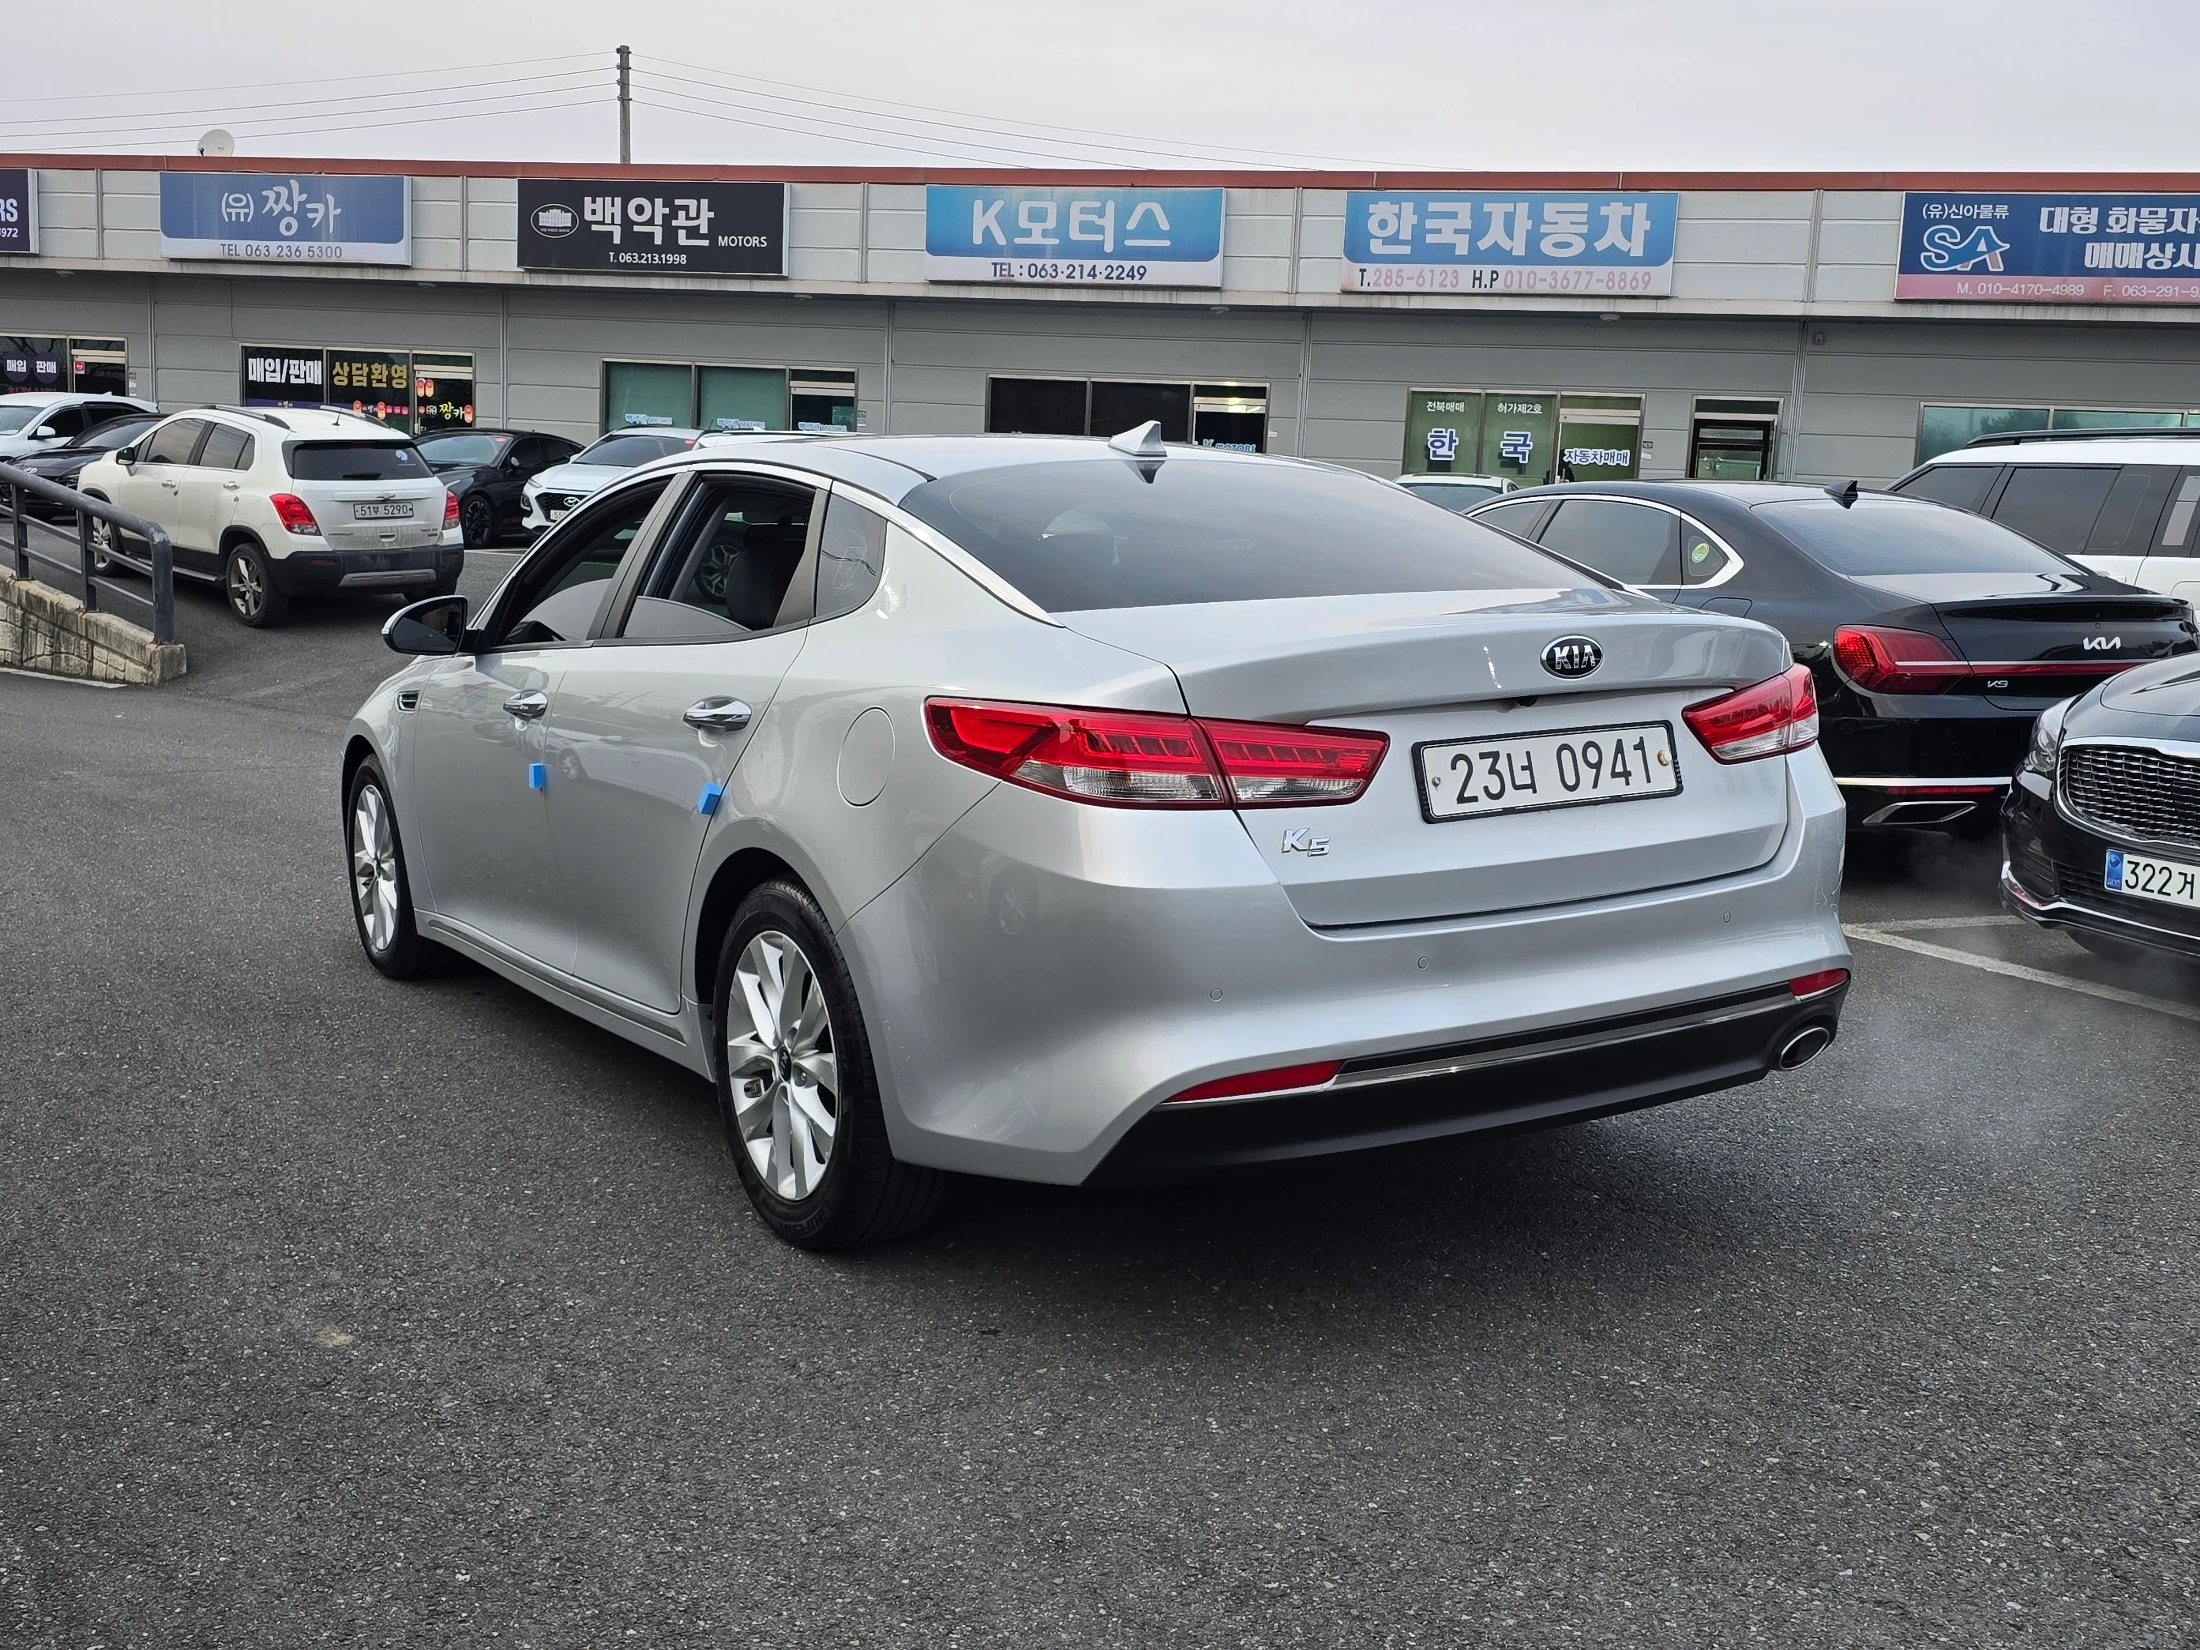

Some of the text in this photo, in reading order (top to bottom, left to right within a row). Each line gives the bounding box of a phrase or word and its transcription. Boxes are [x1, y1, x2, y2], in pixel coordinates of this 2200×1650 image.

[262, 179, 342, 237] 짱카
[584, 196, 768, 248] 백악관 MOTORS
[1922, 203, 2010, 220] (유)신아물류
[2039, 206, 2200, 235] 대형 화물자
[0, 227, 18, 238] 972
[972, 199, 1172, 253] K모터스
[1366, 201, 1651, 258] 한국자동차
[220, 243, 343, 259] TEL 063 236 5300
[1920, 224, 2011, 272] SA
[1503, 269, 1652, 292] 010-3677-8869
[1956, 282, 2200, 298] M. 010-4170-4989 F. 063-291-9
[6, 359, 57, 374] 매입 판매
[248, 357, 323, 385] 매입/판매
[332, 361, 408, 389] 상담환영
[1426, 400, 1543, 415] 전북매매 허가제2호
[1427, 428, 1630, 467] 한 국 자동차매매
[384, 504, 408, 516] 5290
[1553, 644, 1596, 670] KIA
[1449, 735, 1652, 805] 23너 0941
[1282, 826, 1331, 857] K5
[2124, 860, 2195, 900] 322거
